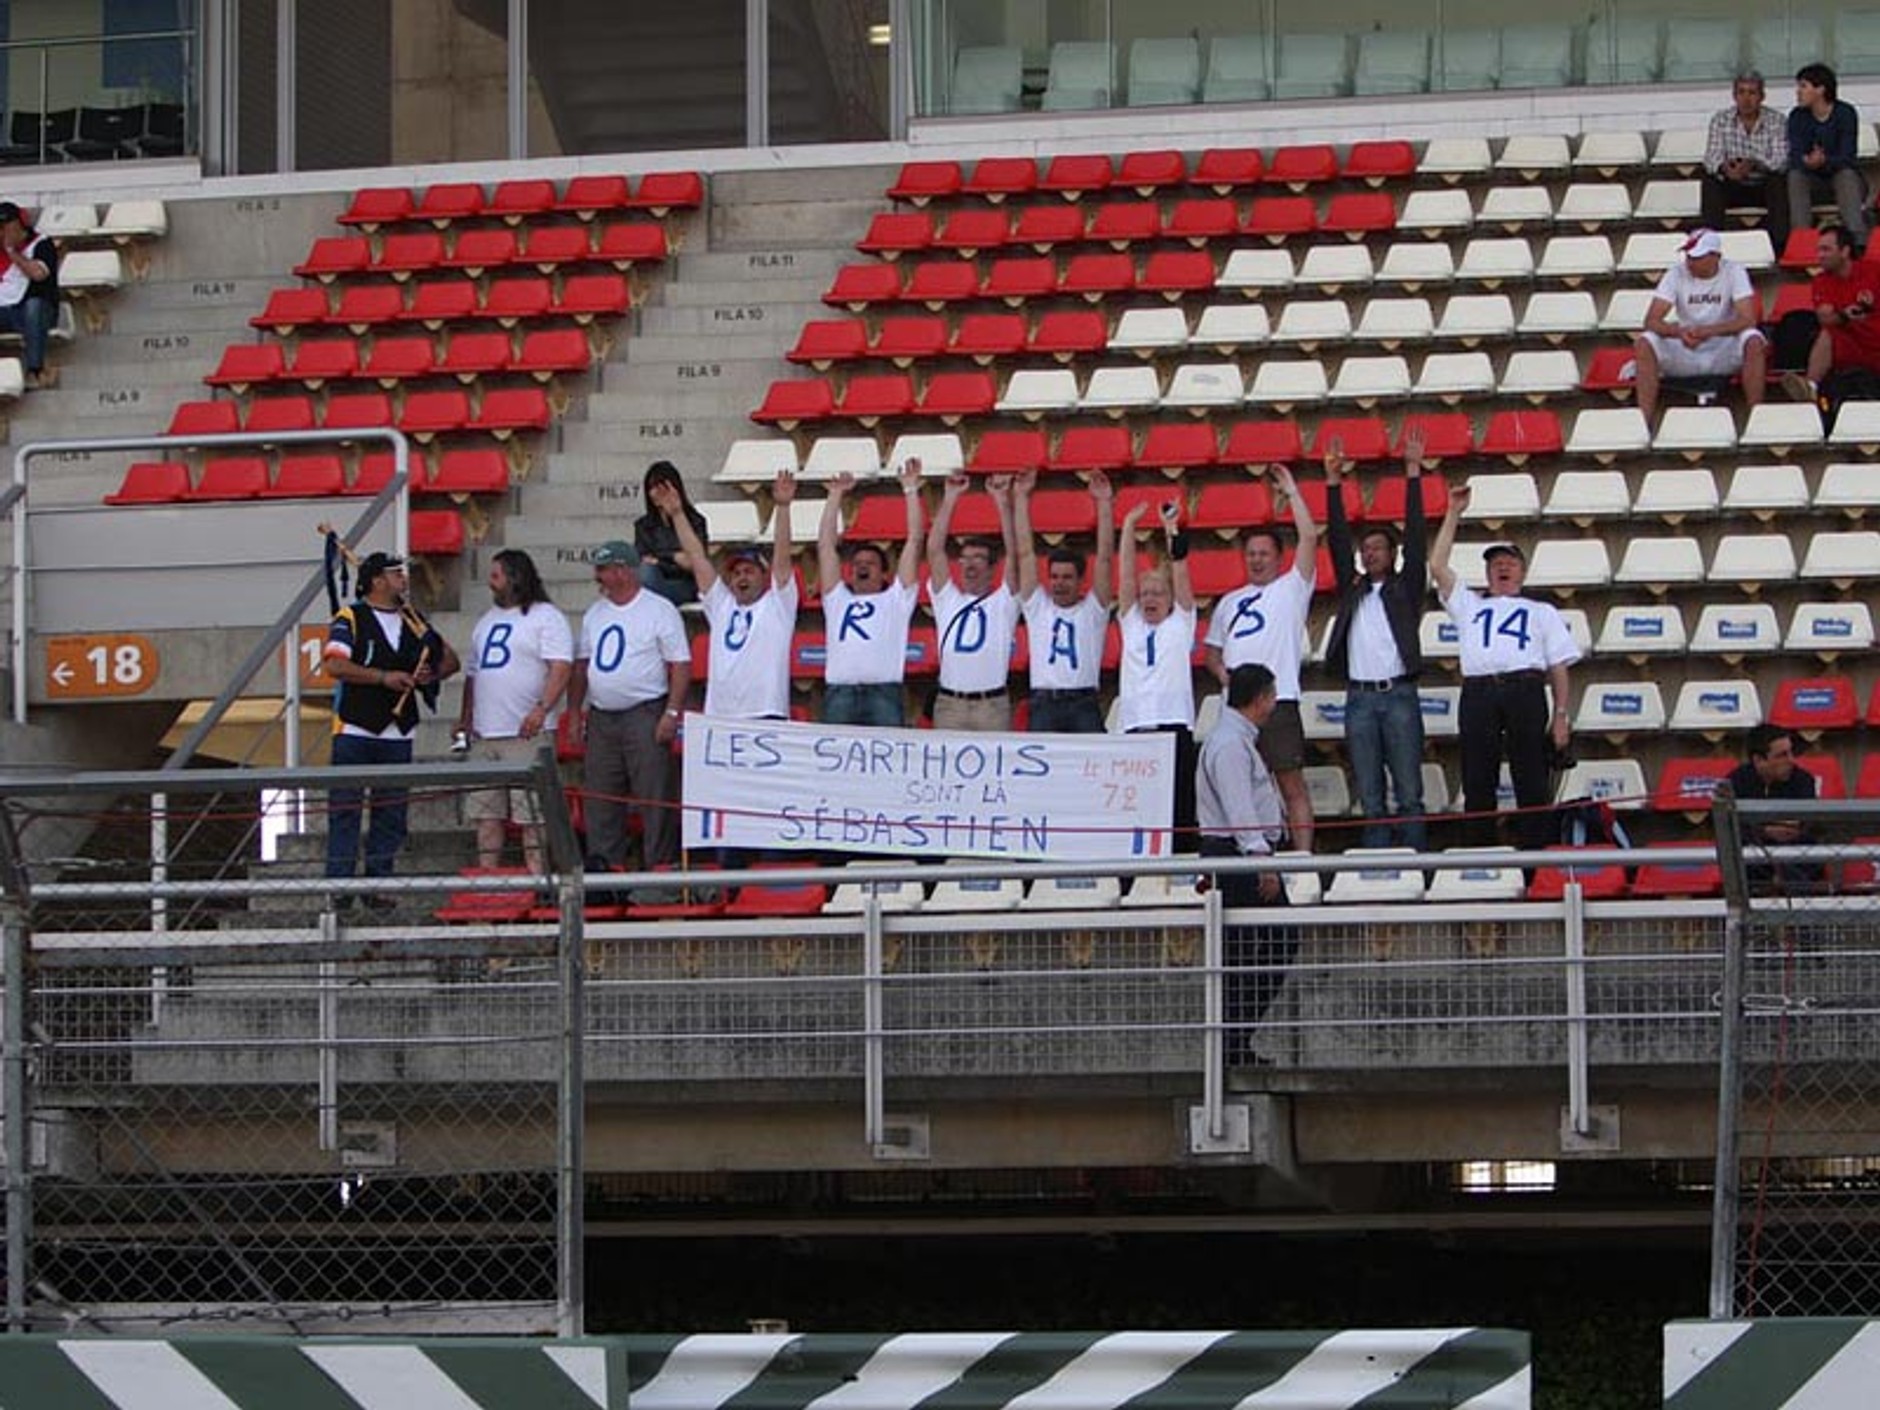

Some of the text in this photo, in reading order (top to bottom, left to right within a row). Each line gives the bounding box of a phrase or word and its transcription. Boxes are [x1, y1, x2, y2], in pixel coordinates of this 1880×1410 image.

[749, 254, 779, 267] FILA
[192, 282, 221, 295] FILA
[714, 306, 764, 320] FILA 10
[143, 335, 190, 349] FILA 10
[677, 364, 709, 378] FILA
[99, 391, 128, 405] FILA
[640, 424, 670, 437] FILA
[599, 485, 631, 499] FILA
[556, 548, 589, 563] FILA
[723, 609, 753, 653] U
[839, 602, 875, 642] R
[953, 602, 987, 654] D
[1472, 607, 1532, 651] 14
[480, 622, 513, 669] B
[595, 623, 626, 673] O
[1047, 616, 1079, 670] A
[1145, 629, 1156, 667] I
[87, 644, 143, 686] 18
[704, 728, 1051, 780] LES SARTHOIS
[906, 779, 966, 805] SONT
[1102, 782, 1137, 812] 72
[778, 798, 1048, 852] SÉBASTIEN
